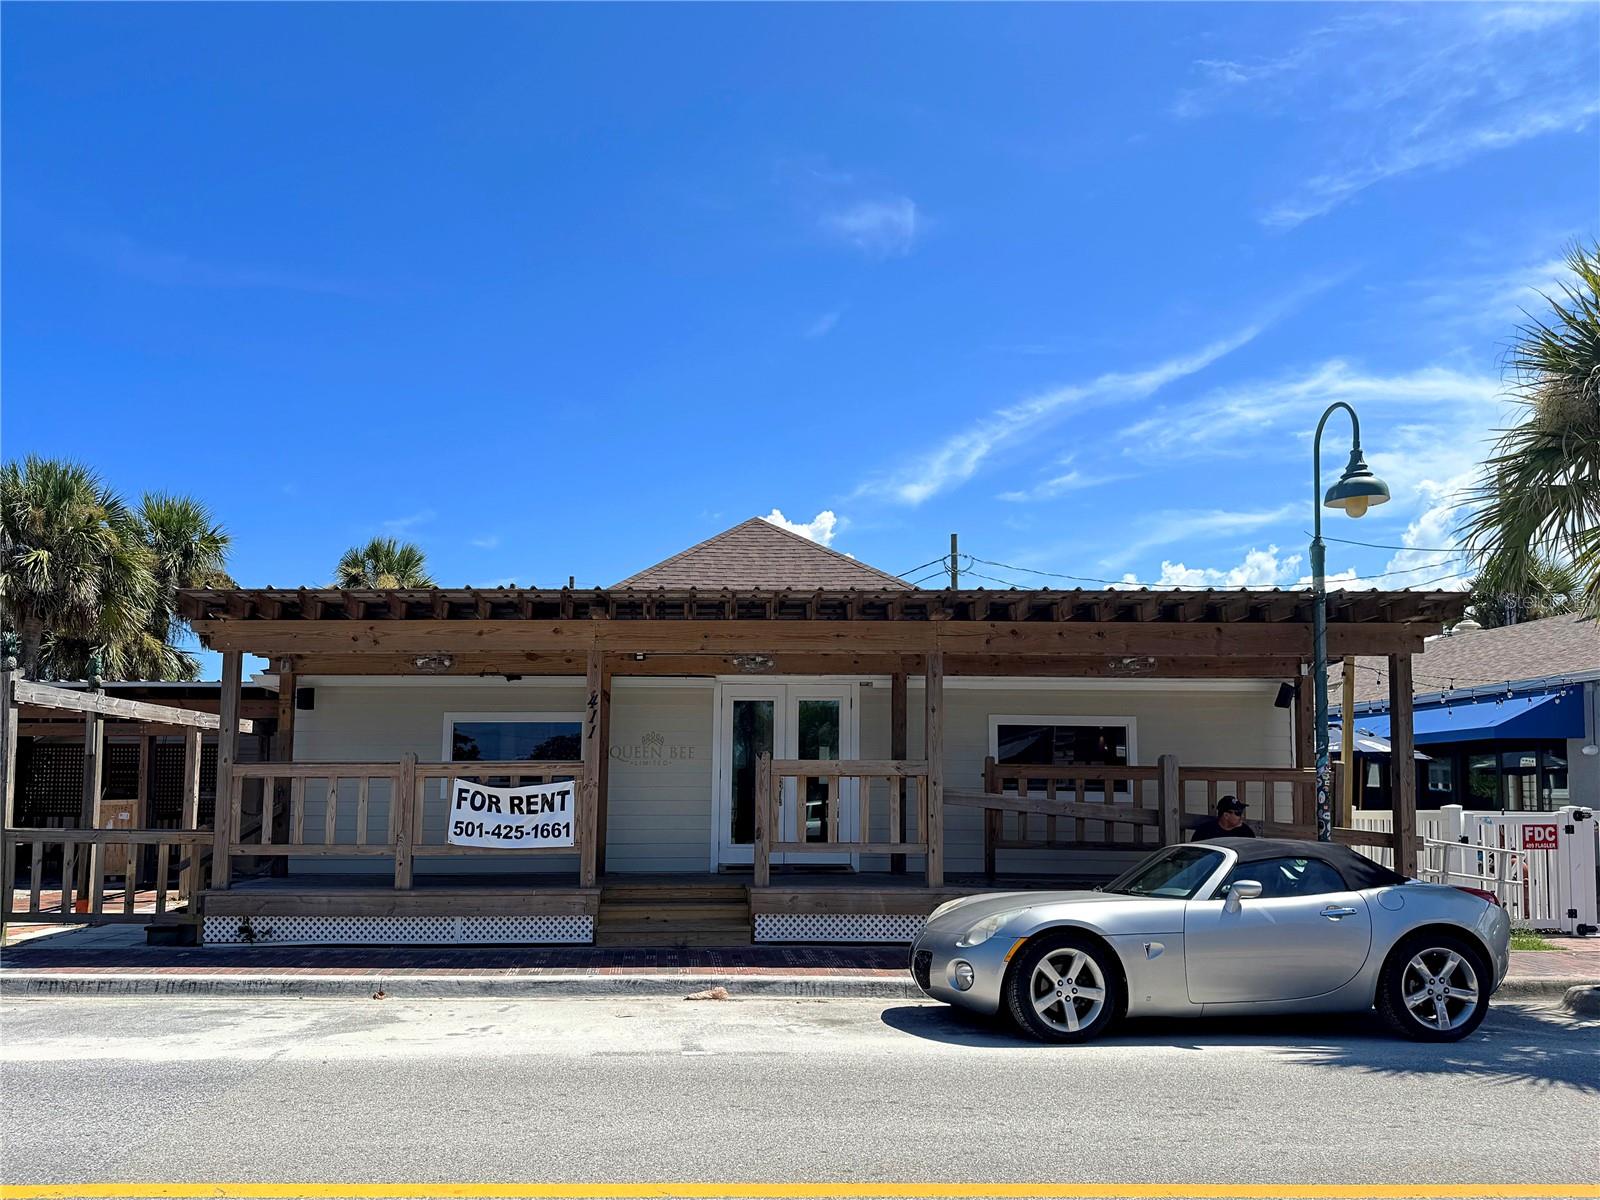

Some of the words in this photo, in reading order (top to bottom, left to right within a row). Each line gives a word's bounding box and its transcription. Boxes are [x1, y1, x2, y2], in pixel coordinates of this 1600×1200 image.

[587, 693, 599, 739] 411
[609, 744, 662, 763] QUEEN
[670, 746, 696, 760] BEE
[456, 788, 502, 814] FOR
[509, 790, 571, 815] RENT
[453, 820, 571, 840] 501-425-1661
[1524, 826, 1556, 842] FDC
